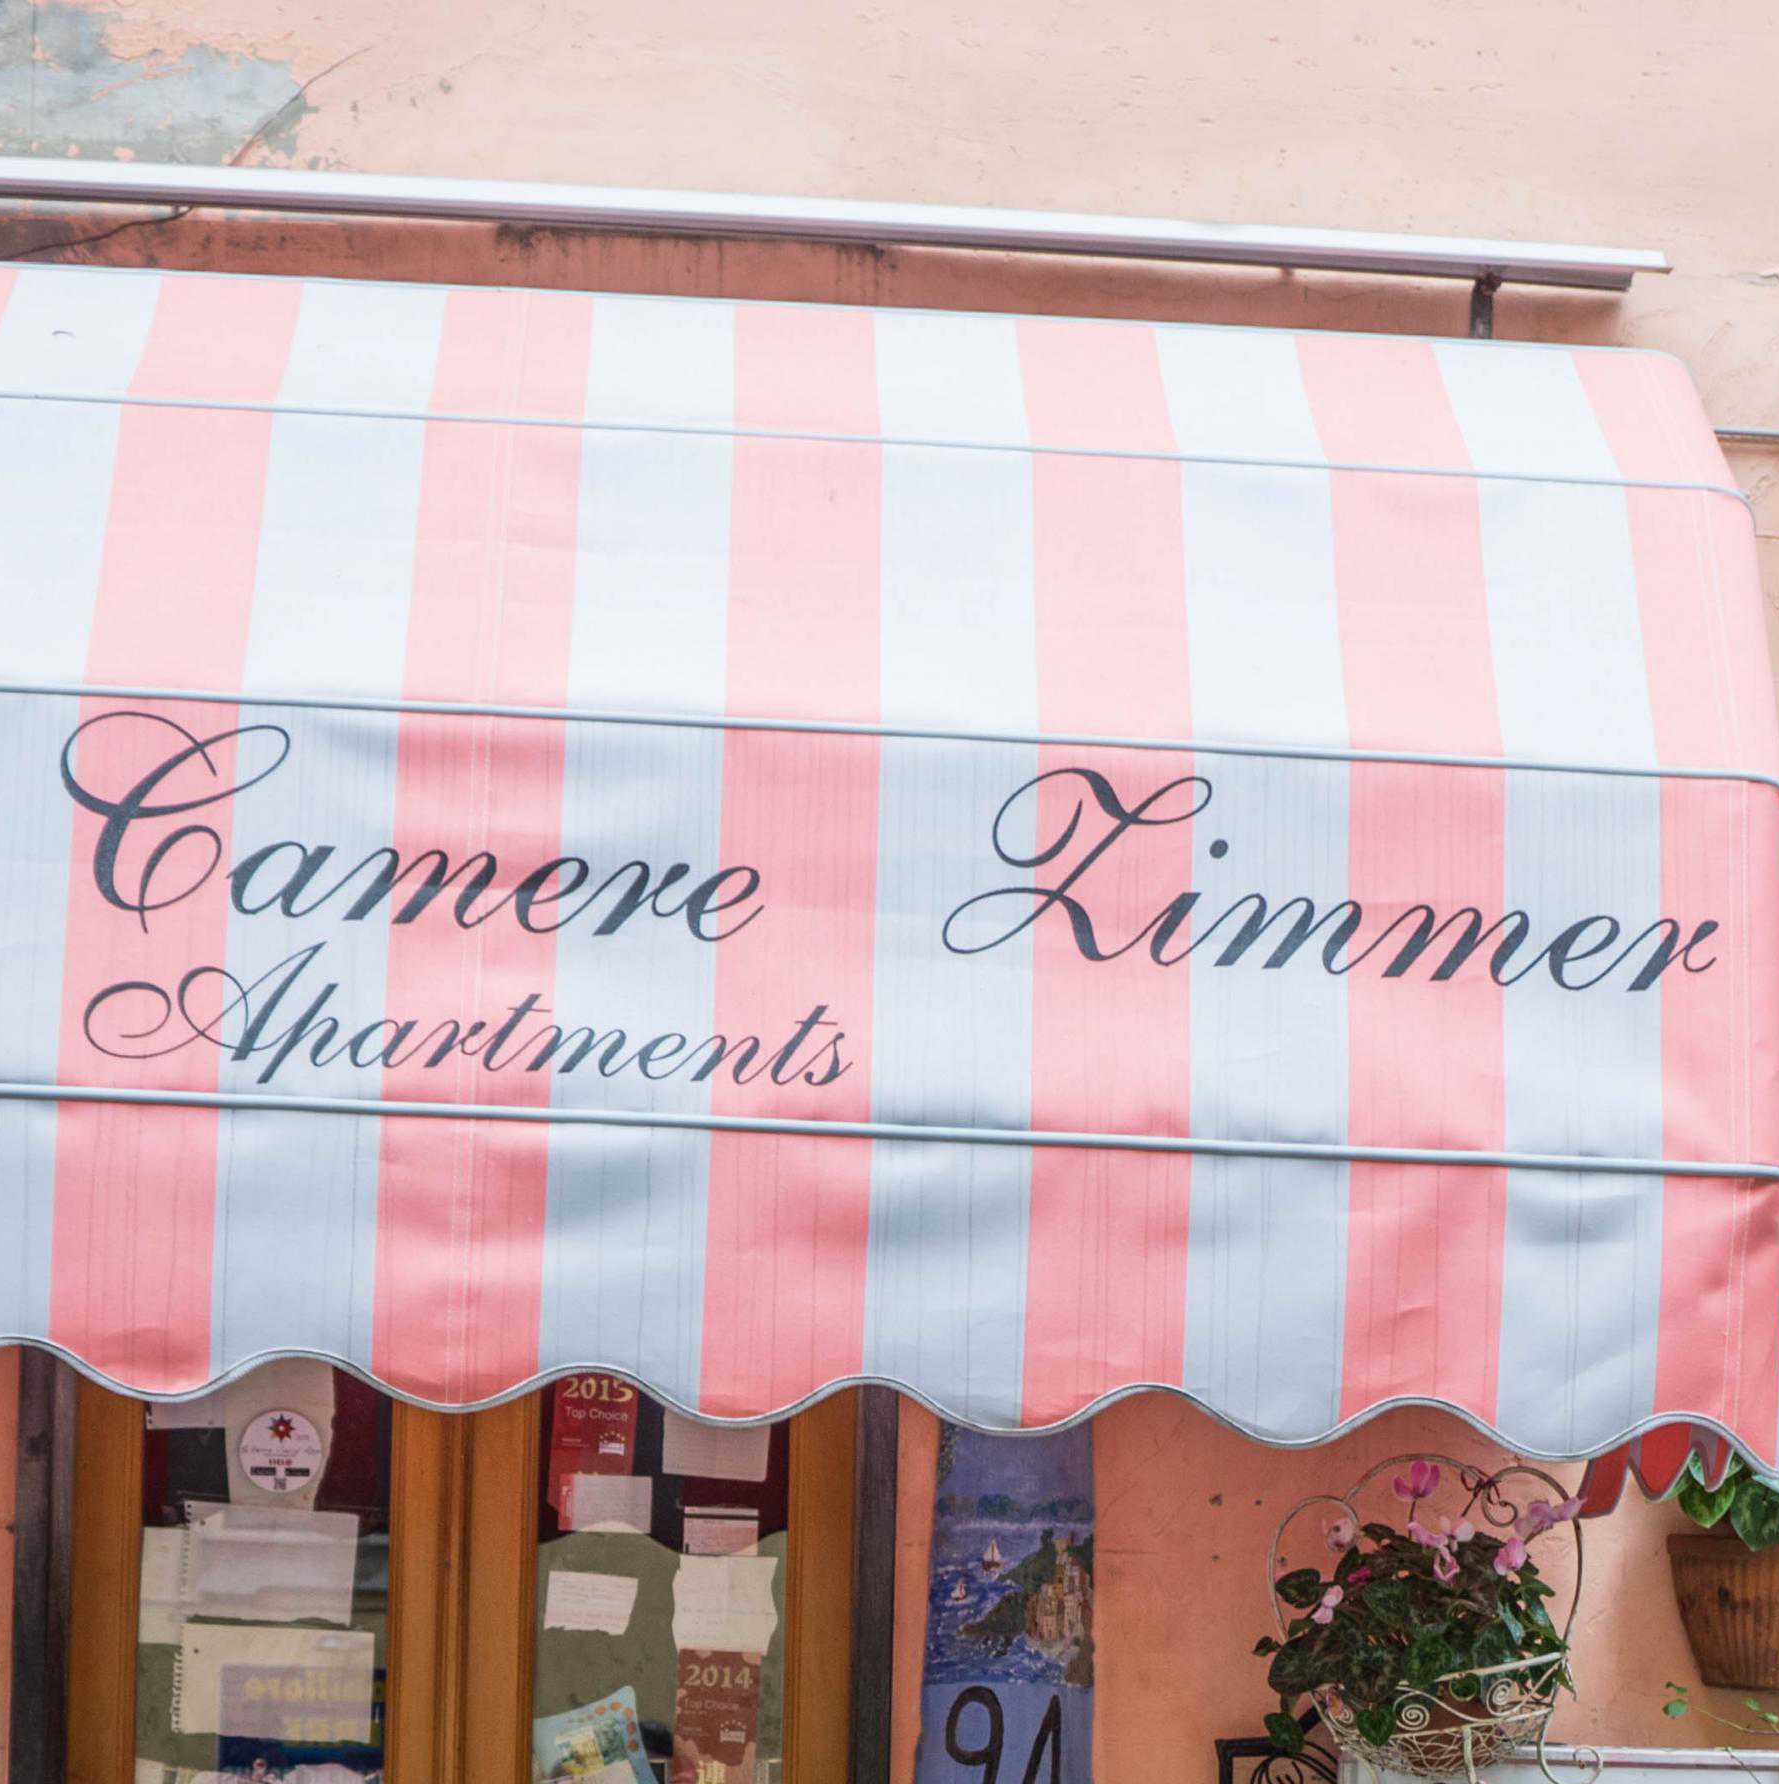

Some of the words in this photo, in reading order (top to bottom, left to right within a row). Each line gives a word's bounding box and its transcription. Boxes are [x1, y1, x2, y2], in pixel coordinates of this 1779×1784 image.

[61, 711, 765, 935] Camere
[942, 767, 1718, 993] Zimmer
[83, 941, 854, 1087] Apartments
[563, 1376, 634, 1403] 2015
[565, 1405, 587, 1420] Top
[589, 1408, 629, 1422] Choice
[685, 1664, 754, 1690] 2014
